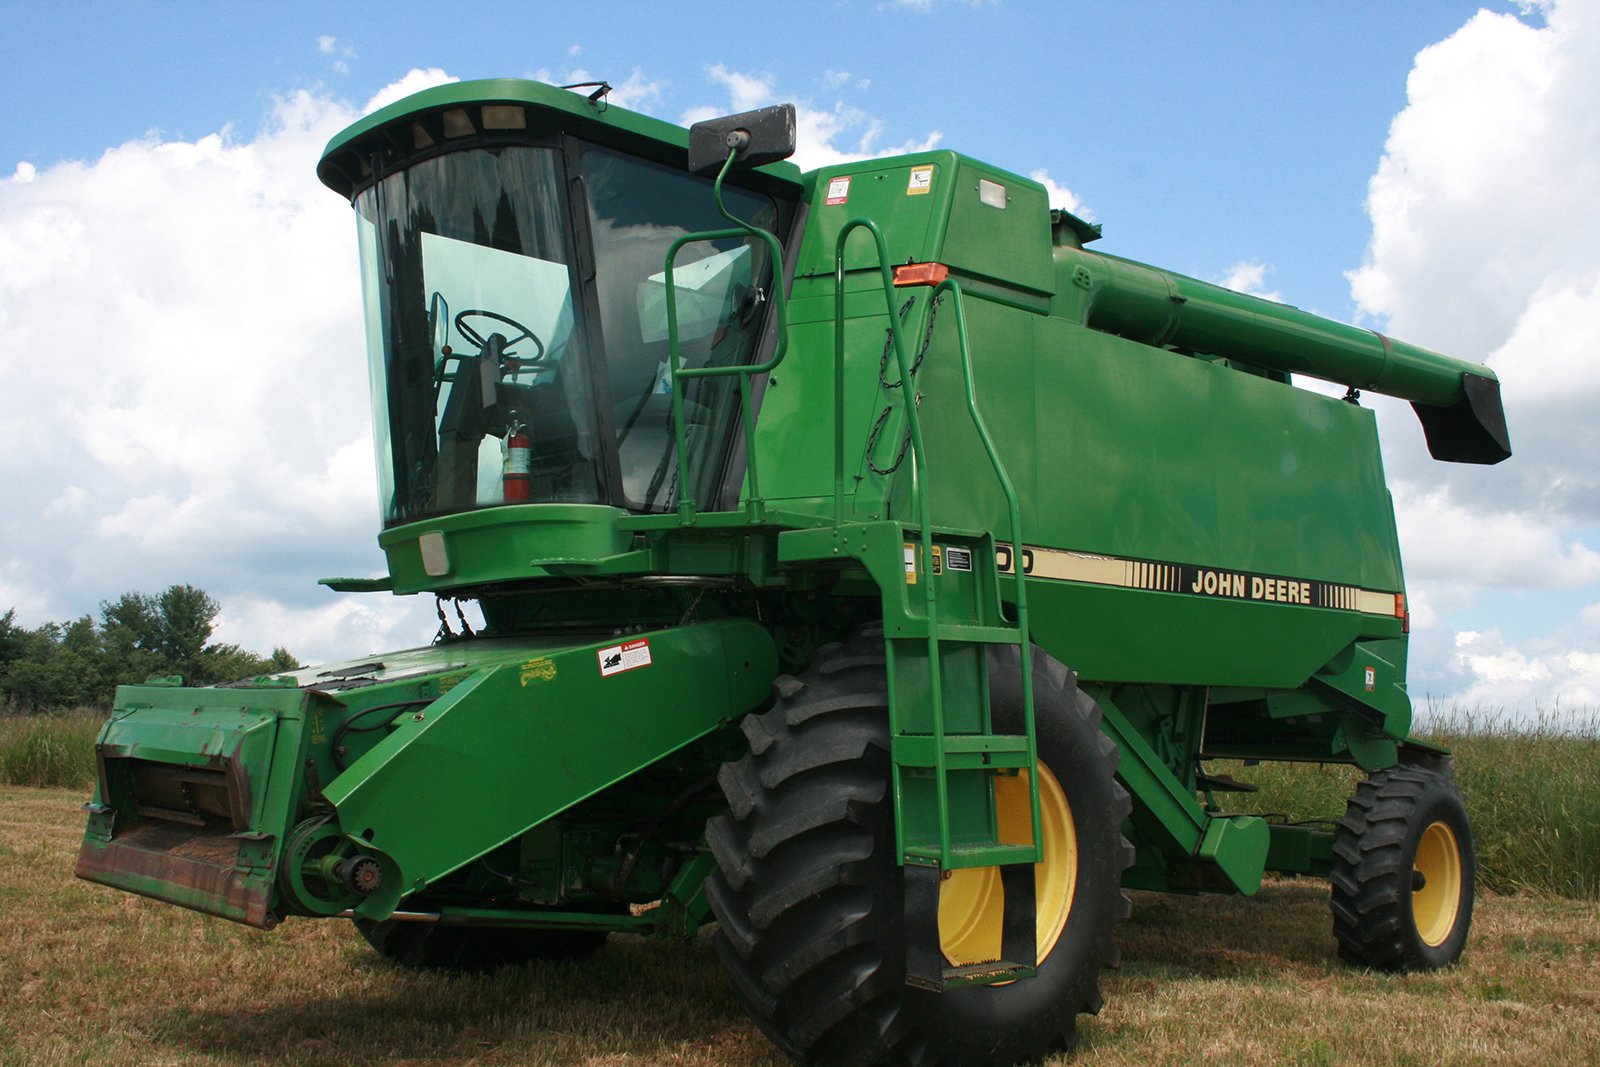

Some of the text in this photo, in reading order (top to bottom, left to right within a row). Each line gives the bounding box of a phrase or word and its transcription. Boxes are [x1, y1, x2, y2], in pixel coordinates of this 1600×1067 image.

[1192, 570, 1311, 604] JOHN DEERE
[628, 641, 646, 650] DANGER
